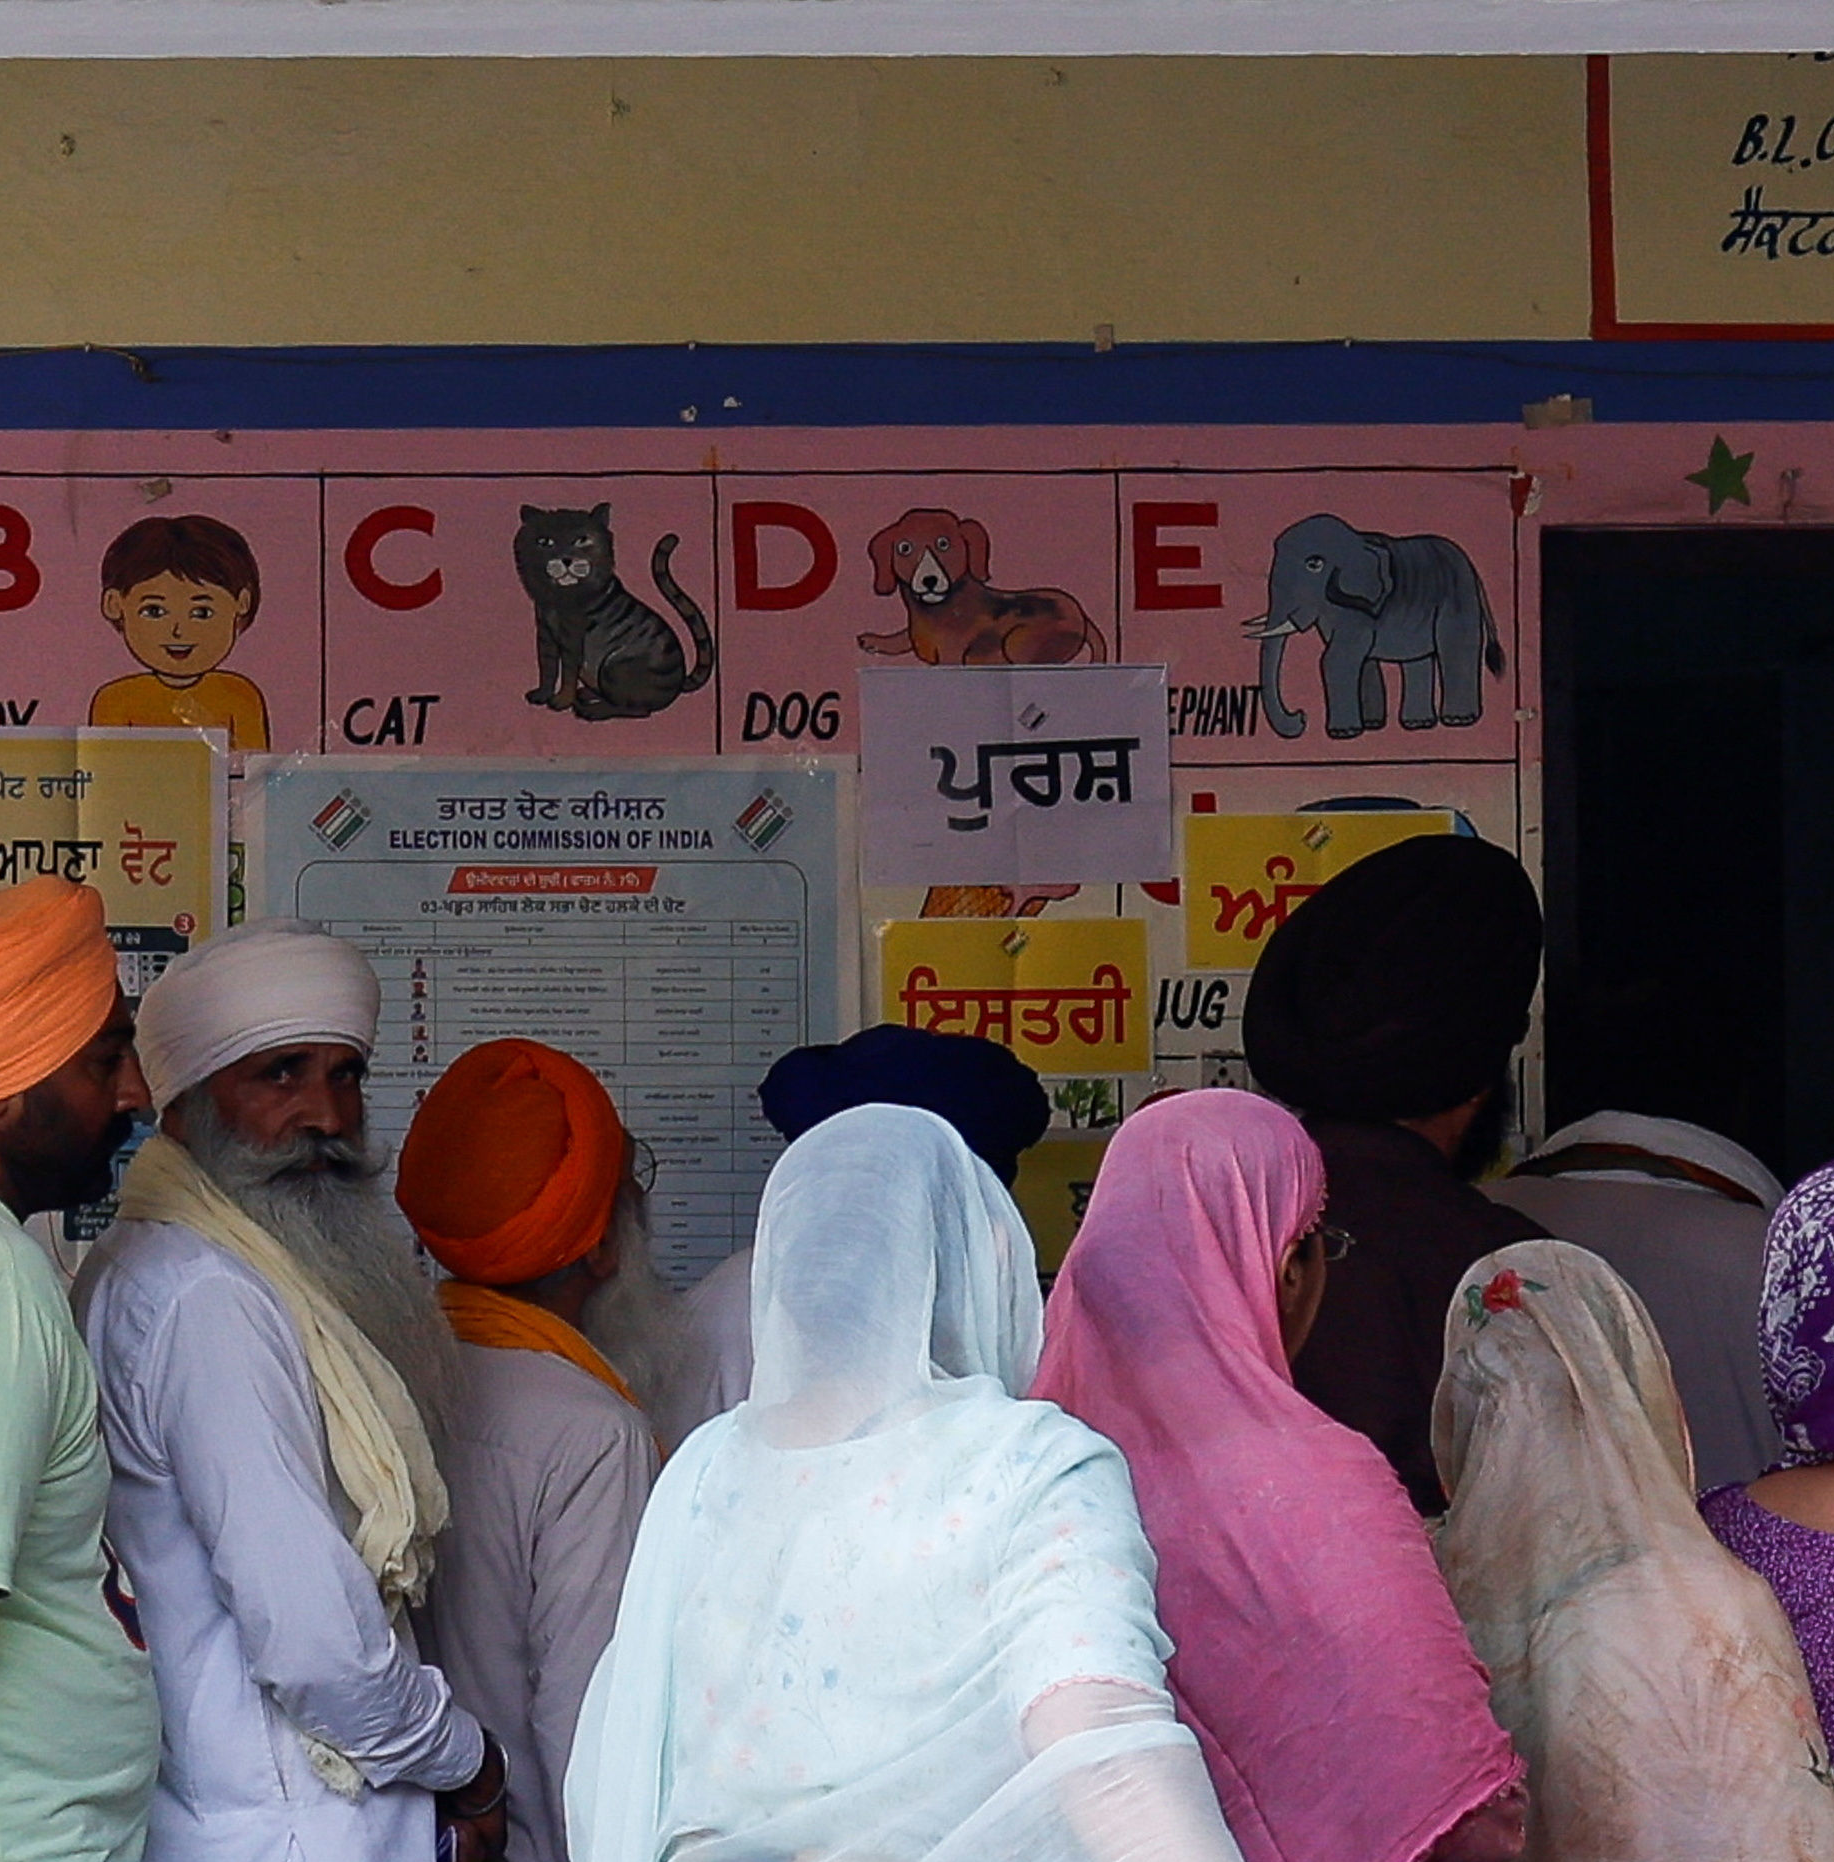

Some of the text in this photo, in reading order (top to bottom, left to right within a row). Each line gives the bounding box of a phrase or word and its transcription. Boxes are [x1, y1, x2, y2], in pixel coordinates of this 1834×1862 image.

[344, 505, 443, 611] C
[731, 501, 838, 612] D
[1132, 501, 1225, 610] E
[343, 695, 441, 746] CAT
[742, 691, 841, 742] DOG
[38, 767, 94, 801] ਰਾਹੀਂ
[436, 789, 666, 822] ਭਾਰਤ ਚੋਣ ਕਮਿਸ਼ਨ
[930, 737, 1140, 832] ਪੁਰਸ਼
[119, 820, 177, 886] ਵੋਟ
[389, 829, 714, 851] ELECTION COMMISSION OF INDIA
[1154, 977, 1230, 1030] JUG
